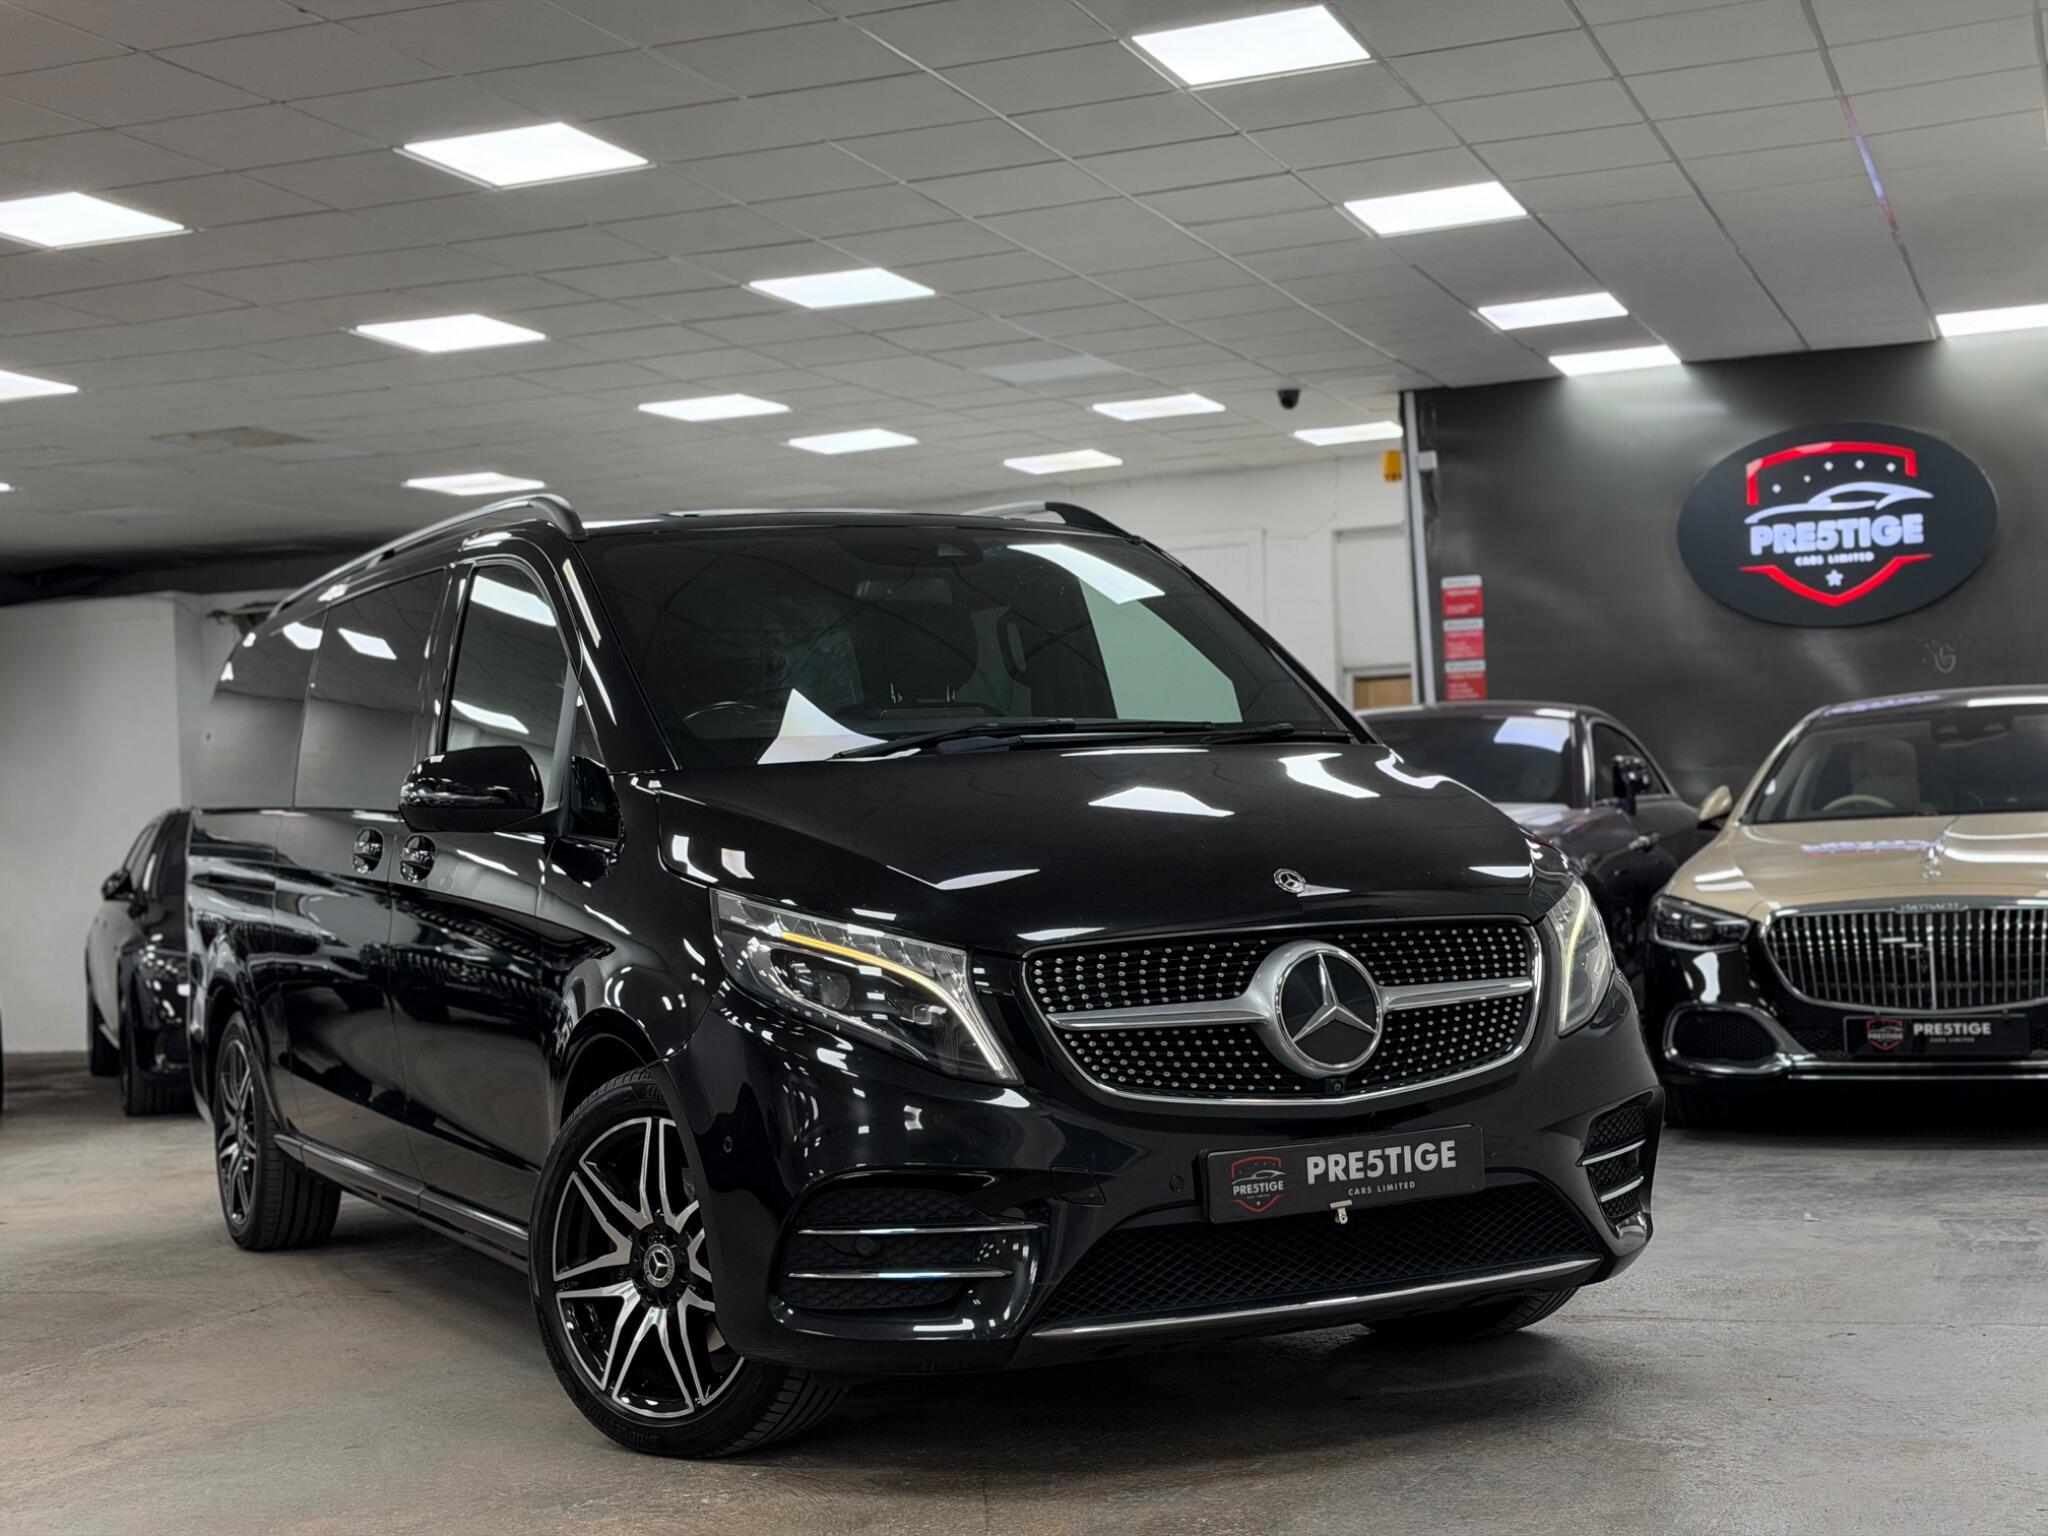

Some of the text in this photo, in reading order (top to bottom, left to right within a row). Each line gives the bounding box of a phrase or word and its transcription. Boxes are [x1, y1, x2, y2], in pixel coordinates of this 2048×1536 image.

[1827, 551, 1875, 564] LIMITED
[1348, 1180, 1416, 1197] CARS LIMITED
